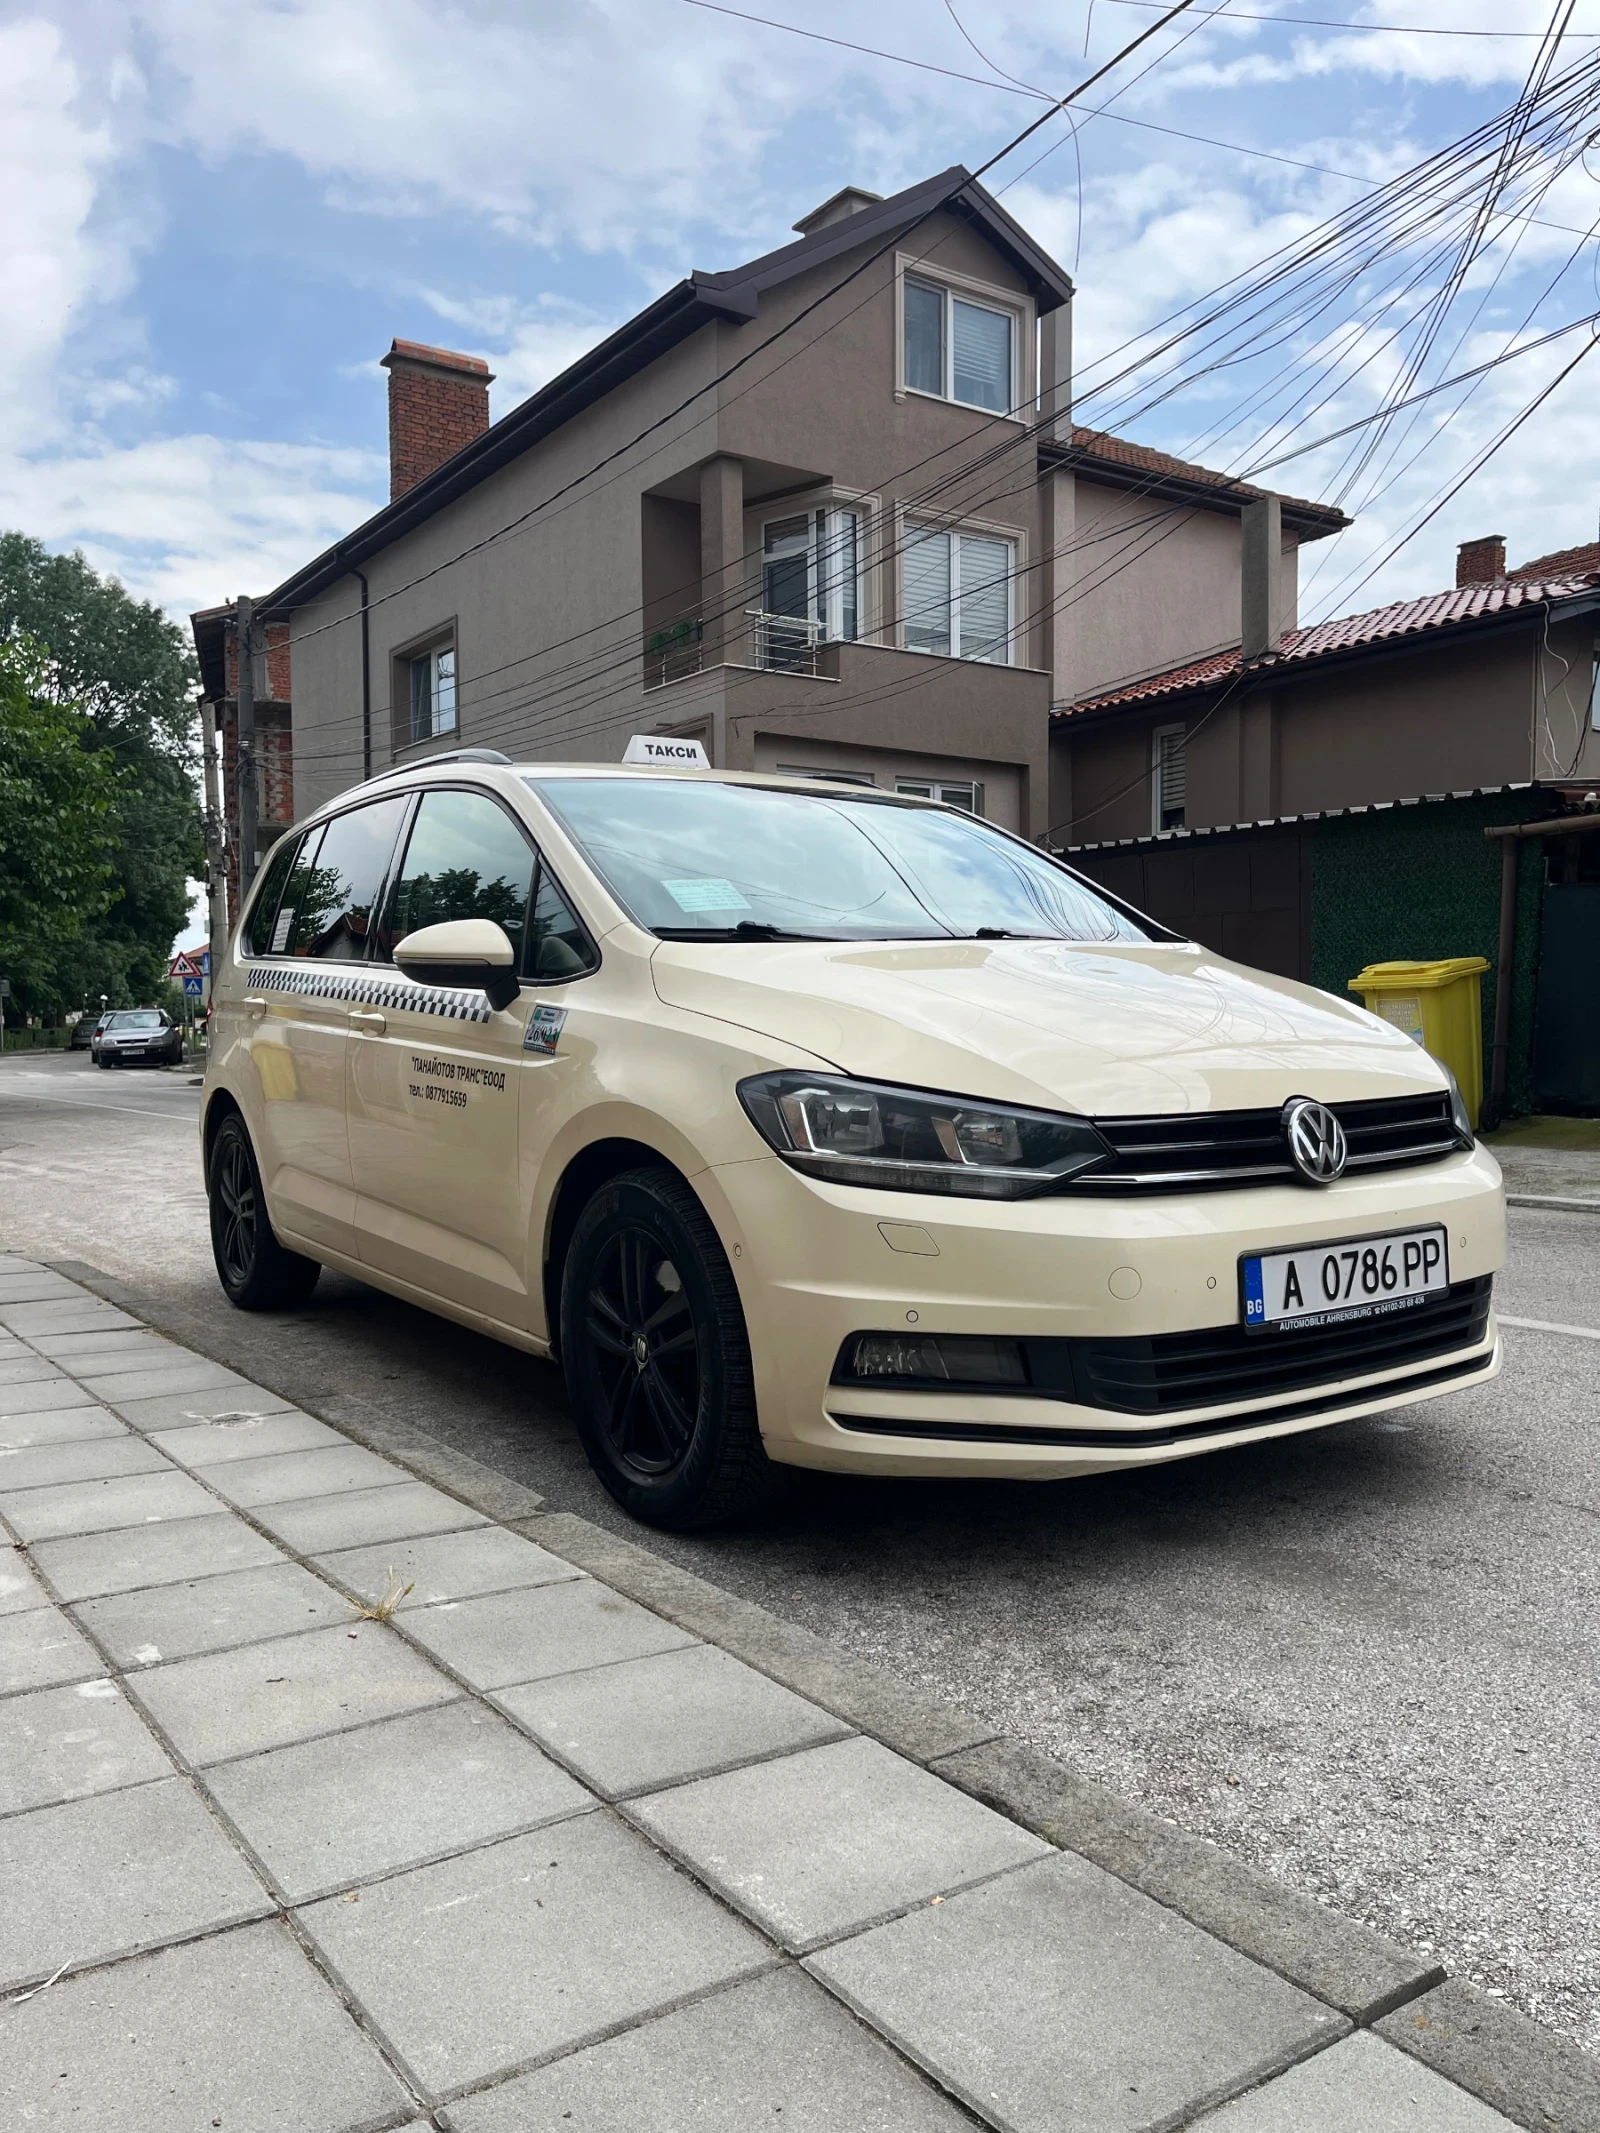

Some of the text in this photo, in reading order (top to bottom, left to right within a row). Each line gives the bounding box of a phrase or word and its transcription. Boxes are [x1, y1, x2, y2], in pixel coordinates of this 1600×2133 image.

[644, 744, 698, 759] ТАКСИ
[425, 1085, 467, 1108] 0877915659
[1247, 1238, 1440, 1316] BG A 0786 PP
[1279, 1315, 1325, 1331] AUTOMOBILE
[1326, 1308, 1372, 1323] AHRENSBURG
